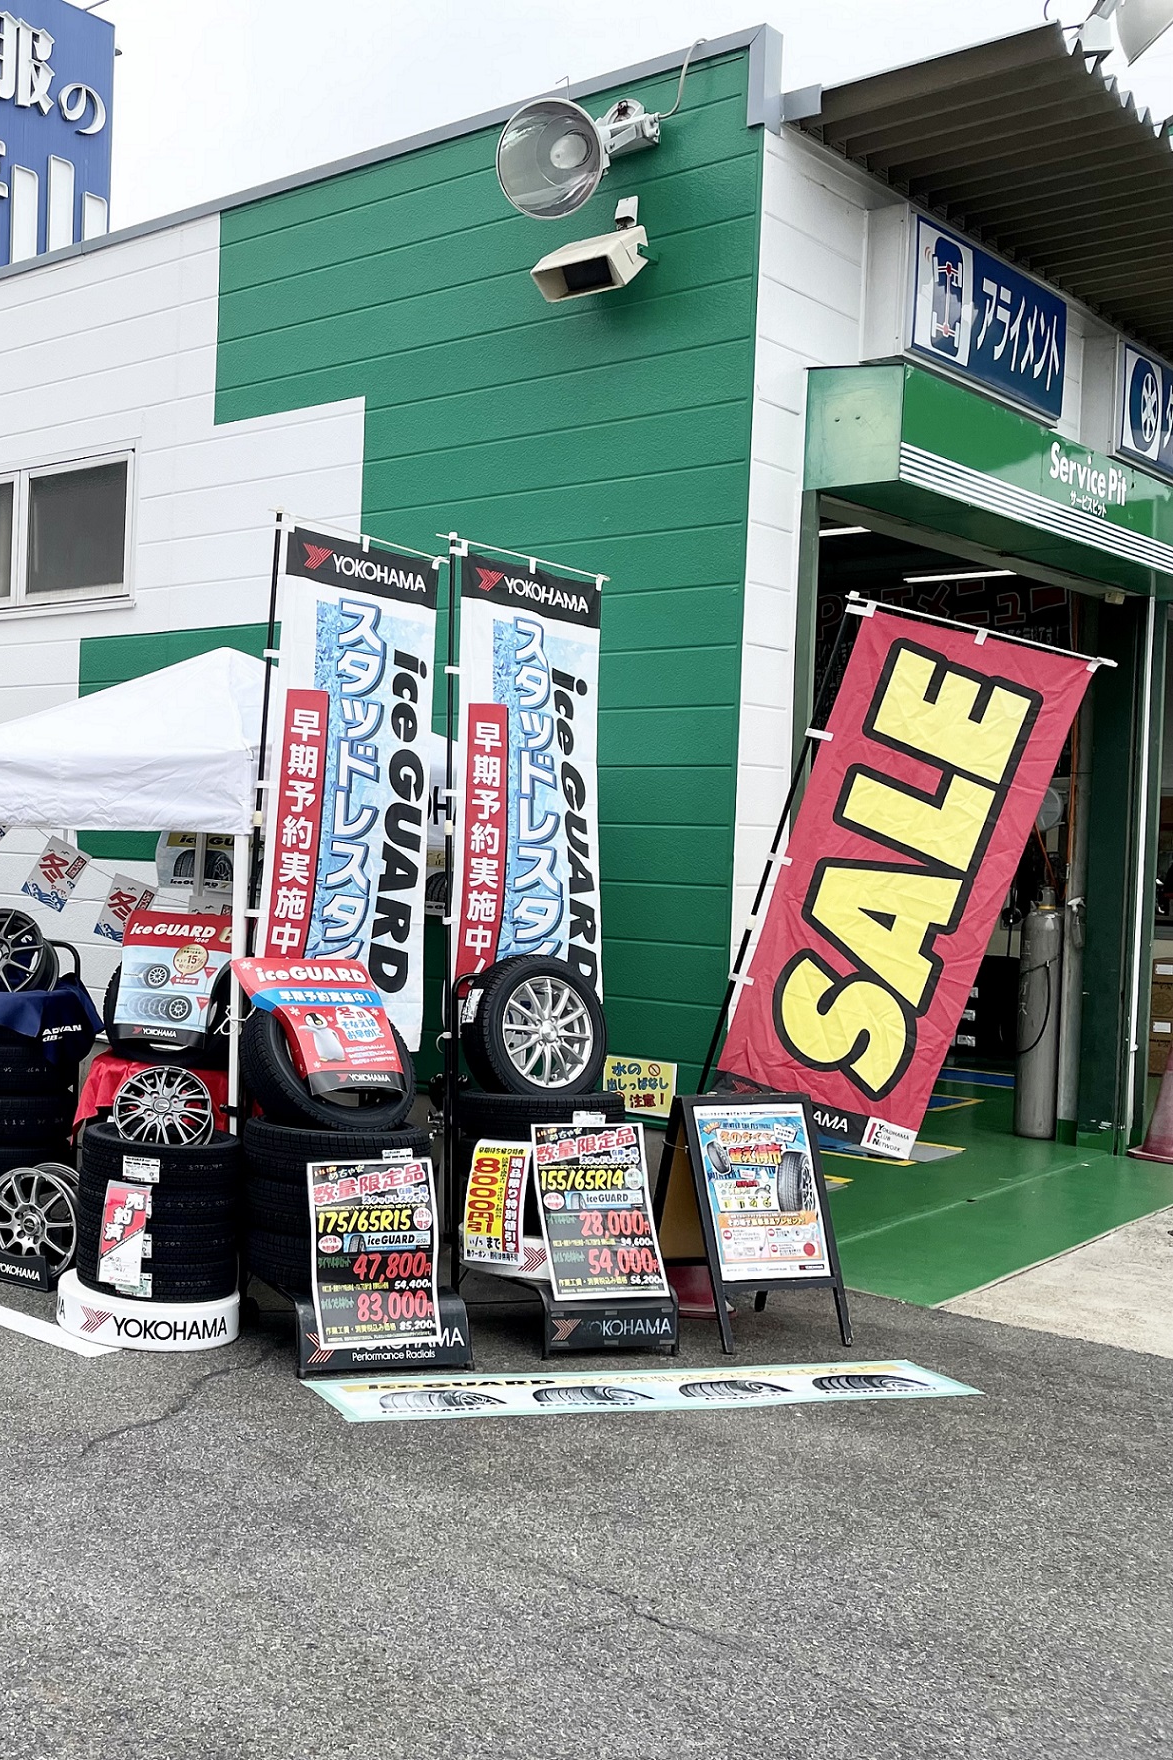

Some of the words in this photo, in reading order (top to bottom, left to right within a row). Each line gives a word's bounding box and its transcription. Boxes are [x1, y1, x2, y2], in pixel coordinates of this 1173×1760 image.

[977, 277, 1060, 391] アライメント
[1049, 441, 1106, 498] Service
[1108, 466, 1126, 506] Pit
[332, 553, 426, 593] YOKOHAMA
[504, 575, 589, 614] YOKOHAMA
[775, 638, 1042, 1100] SALE
[130, 922, 217, 938] iceGUARD
[255, 966, 367, 984] iceGUARD
[42, 1024, 82, 1036] ADVAN
[142, 1027, 177, 1038] YOKOHAMA
[348, 1073, 392, 1083] YOKOHAMA
[611, 1061, 642, 1077] 水の
[536, 1127, 636, 1163] 数量限定品
[313, 1164, 427, 1204] 数量限定品
[541, 1169, 625, 1191] 155/65R14
[586, 1193, 629, 1204] iceGUARD
[318, 1209, 413, 1234] 175/65R15
[367, 1234, 415, 1245] iceGUARD
[113, 1315, 227, 1341] YOKOHAMA
[352, 1350, 405, 1362] Performance
[406, 1348, 436, 1359] Radials
